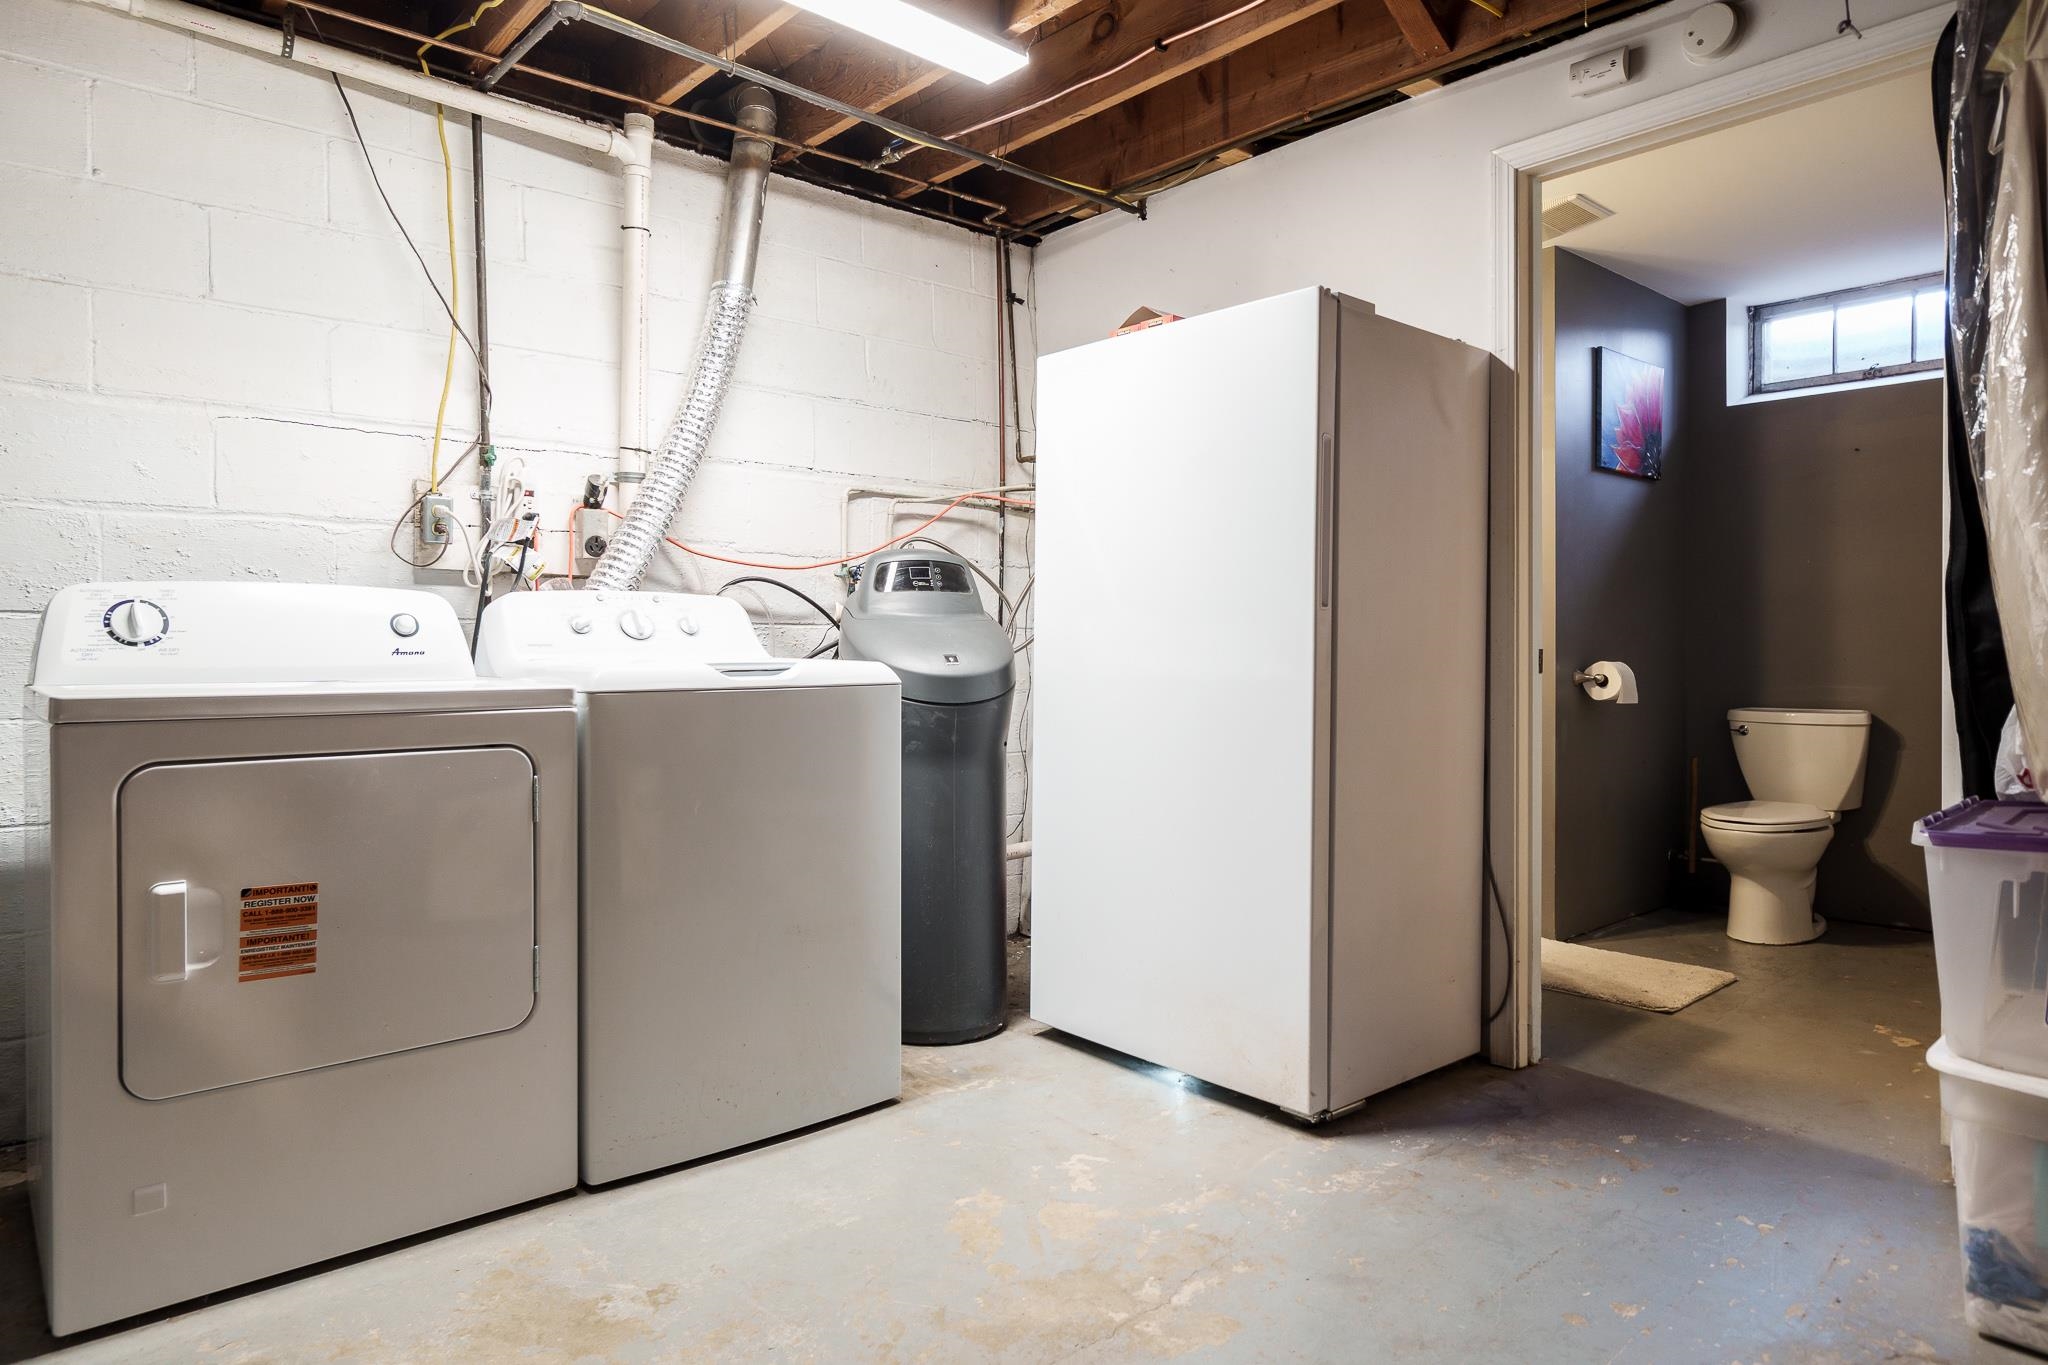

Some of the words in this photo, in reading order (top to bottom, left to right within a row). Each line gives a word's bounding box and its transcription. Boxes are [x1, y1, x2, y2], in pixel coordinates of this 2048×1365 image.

[391, 647, 425, 656] Amana
[244, 898, 291, 908] REGISTER
[293, 895, 315, 903] NOW
